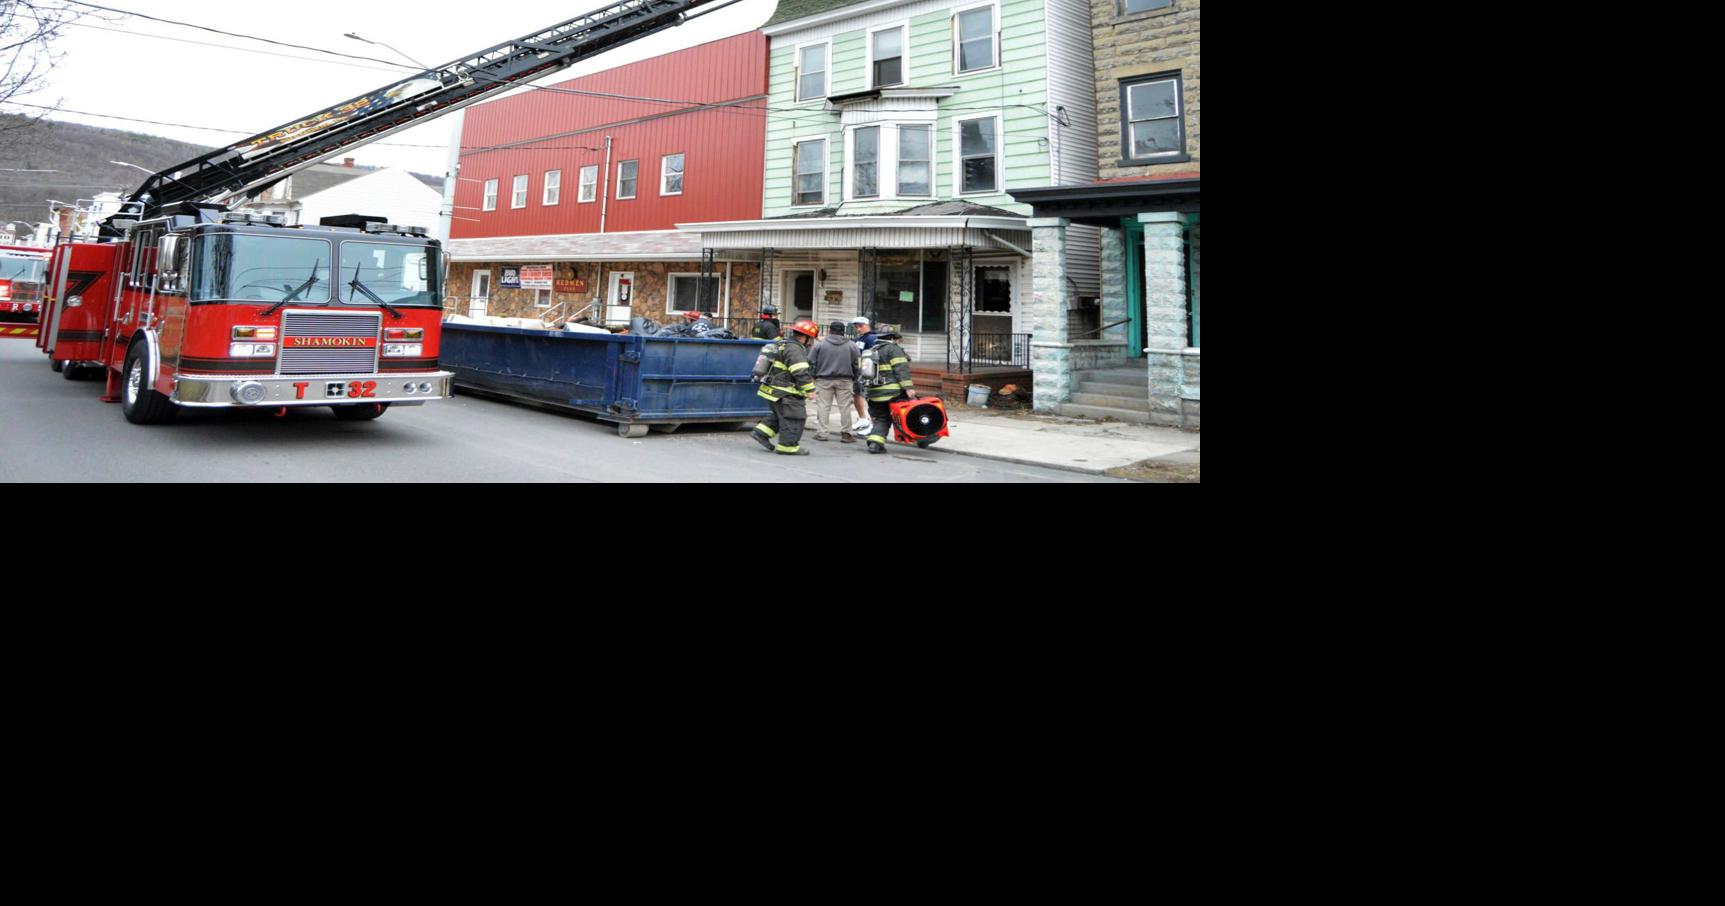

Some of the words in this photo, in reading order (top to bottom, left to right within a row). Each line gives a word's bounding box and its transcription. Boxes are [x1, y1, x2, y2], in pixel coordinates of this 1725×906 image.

[250, 112, 333, 146] TRUCK
[294, 337, 366, 346] SHAMOKIN
[293, 382, 309, 399] T
[347, 380, 377, 398] 32
